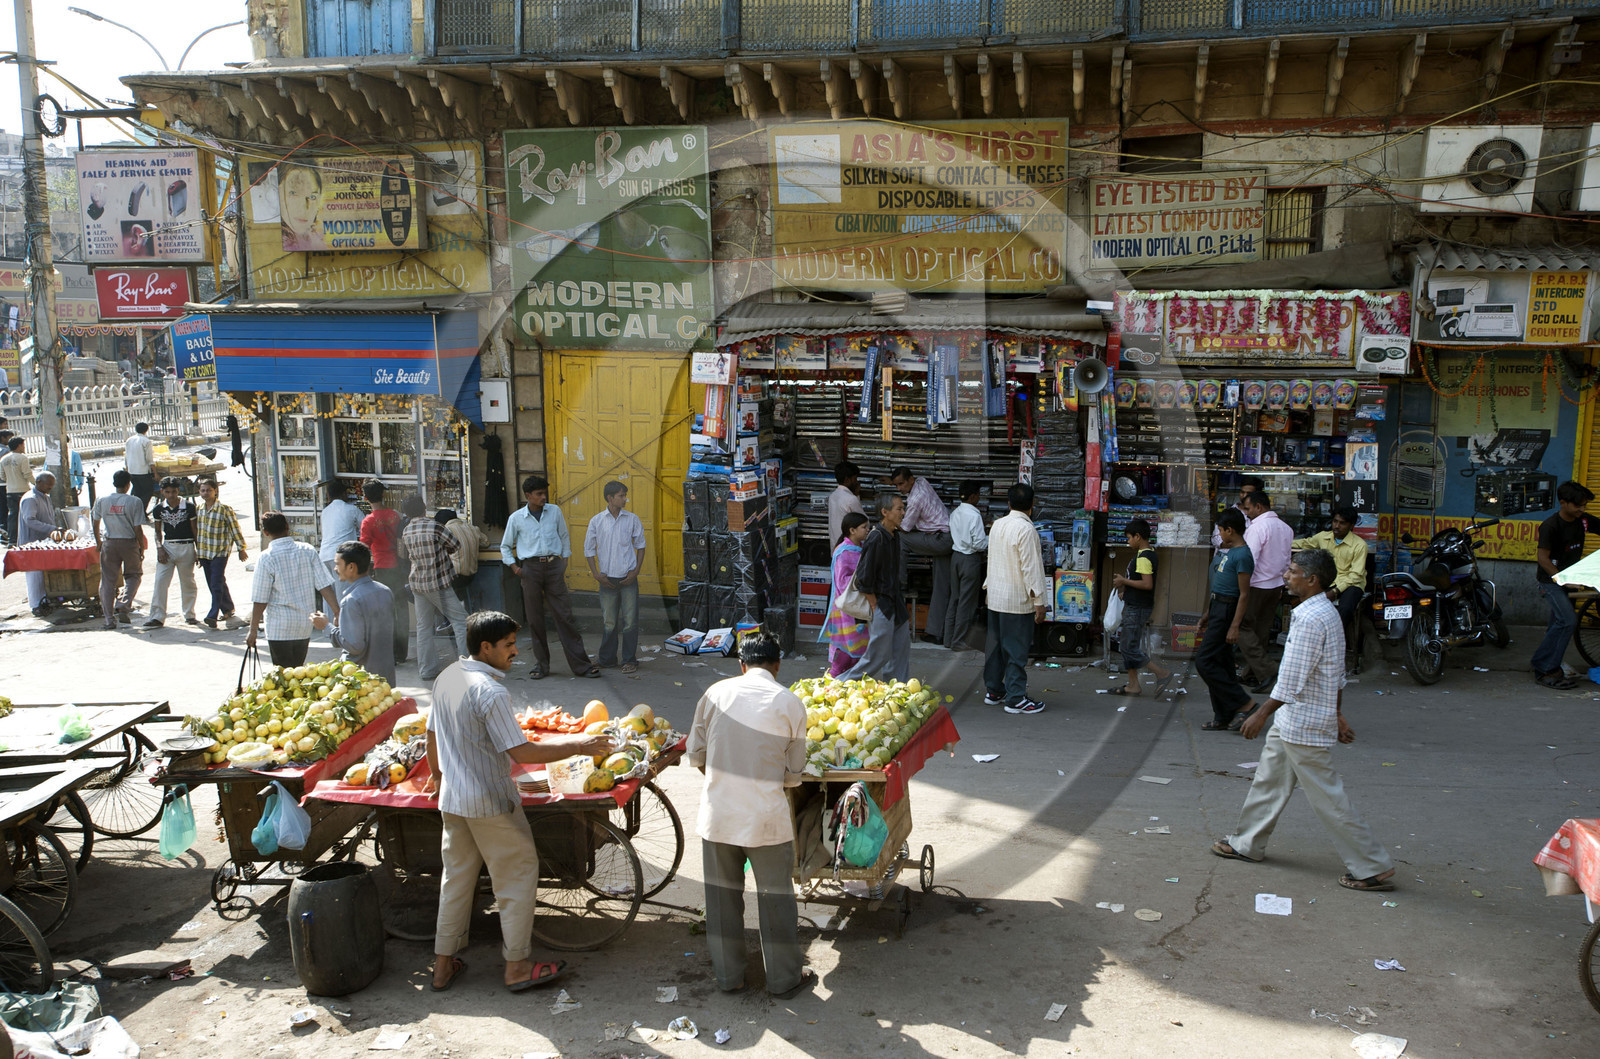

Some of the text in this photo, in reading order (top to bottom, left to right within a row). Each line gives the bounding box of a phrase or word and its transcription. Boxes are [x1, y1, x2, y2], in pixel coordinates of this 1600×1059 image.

[850, 130, 1060, 164] ASIA'S FIRST
[105, 158, 167, 168] HEARING AID
[82, 167, 193, 179] SALES & SERVICE CENTRE
[333, 175, 373, 184] JOHNSON
[843, 165, 1065, 186] SILKEN SOFT CONTACT LENSES
[333, 191, 375, 200] JOHNSON
[619, 178, 696, 197] SUN GLASSES
[1095, 176, 1259, 207] EYE TESTED BY
[878, 189, 1035, 209] DISPOSABLE LENSES
[322, 219, 383, 235] MODERN
[835, 214, 861, 233] CIBA
[901, 214, 957, 234] JOHNSON
[966, 214, 1022, 234] JOHNSON
[1024, 214, 1065, 233] LENSES
[1094, 206, 1264, 236] LATEST COMPUTORS
[331, 237, 375, 248] OPTICALS
[1092, 238, 1142, 259] MODERN
[1146, 236, 1193, 257] OPTICAL
[1197, 235, 1217, 255] CO.
[778, 247, 895, 282] MODERN
[903, 247, 1026, 282] OPTICAL
[258, 267, 345, 294] MODERN
[350, 263, 435, 292] OPTICAL
[526, 280, 694, 309] MODERN
[1535, 287, 1585, 299] INTERCOMS
[1533, 301, 1557, 312] STD
[521, 311, 671, 340] OPTICAL
[1532, 314, 1578, 324] PCO CALL
[1530, 327, 1582, 338] COUNTERS
[190, 352, 198, 363] &
[183, 366, 198, 378] SOFT
[374, 368, 431, 385] She Beauty
